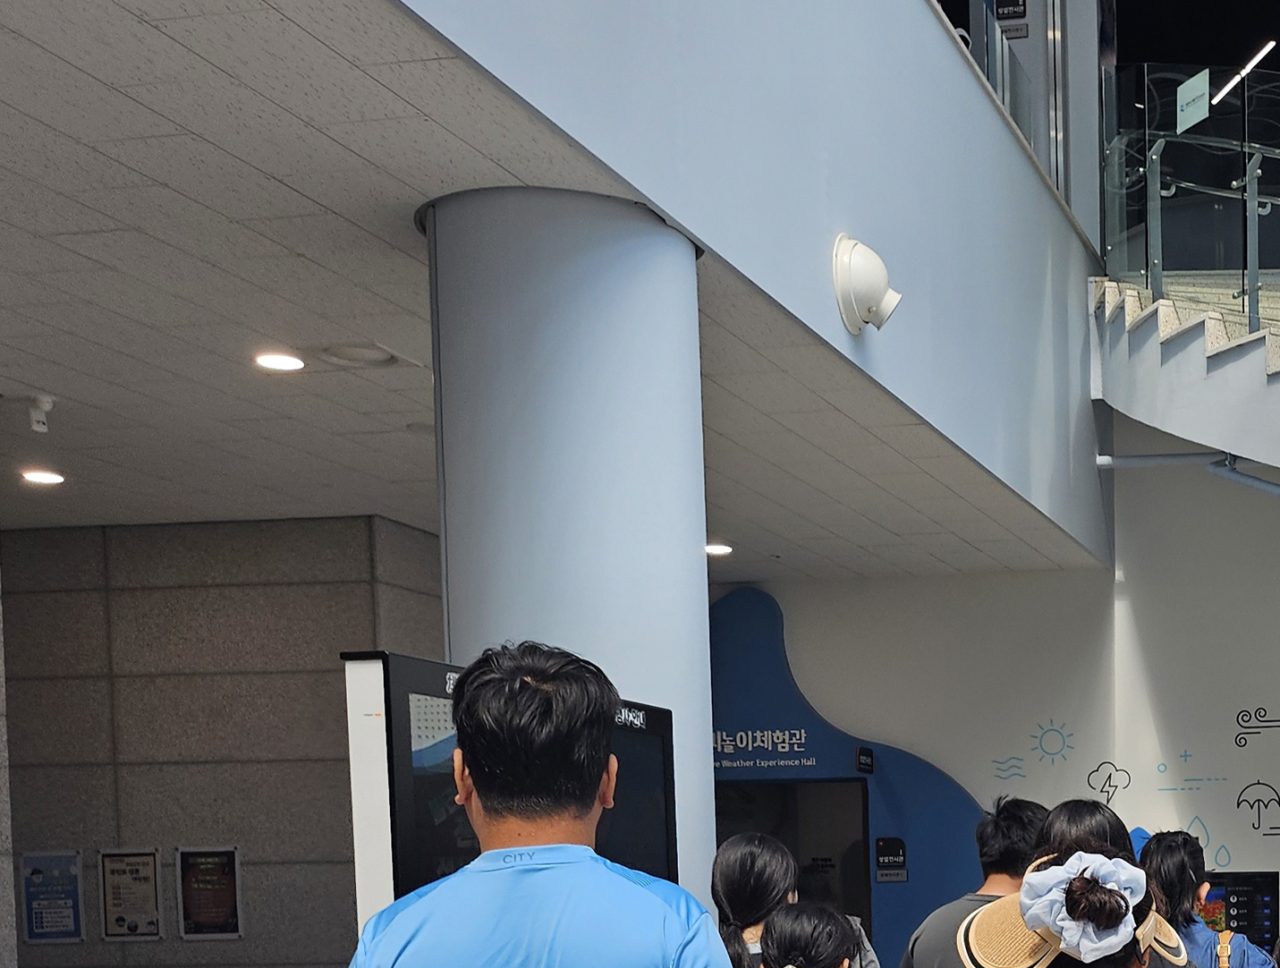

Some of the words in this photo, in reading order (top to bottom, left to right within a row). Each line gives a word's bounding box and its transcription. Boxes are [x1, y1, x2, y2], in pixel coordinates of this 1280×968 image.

[721, 759, 754, 768] Weather
[756, 759, 800, 769] Experience
[801, 757, 817, 766] Hall
[502, 851, 536, 864] CITY
